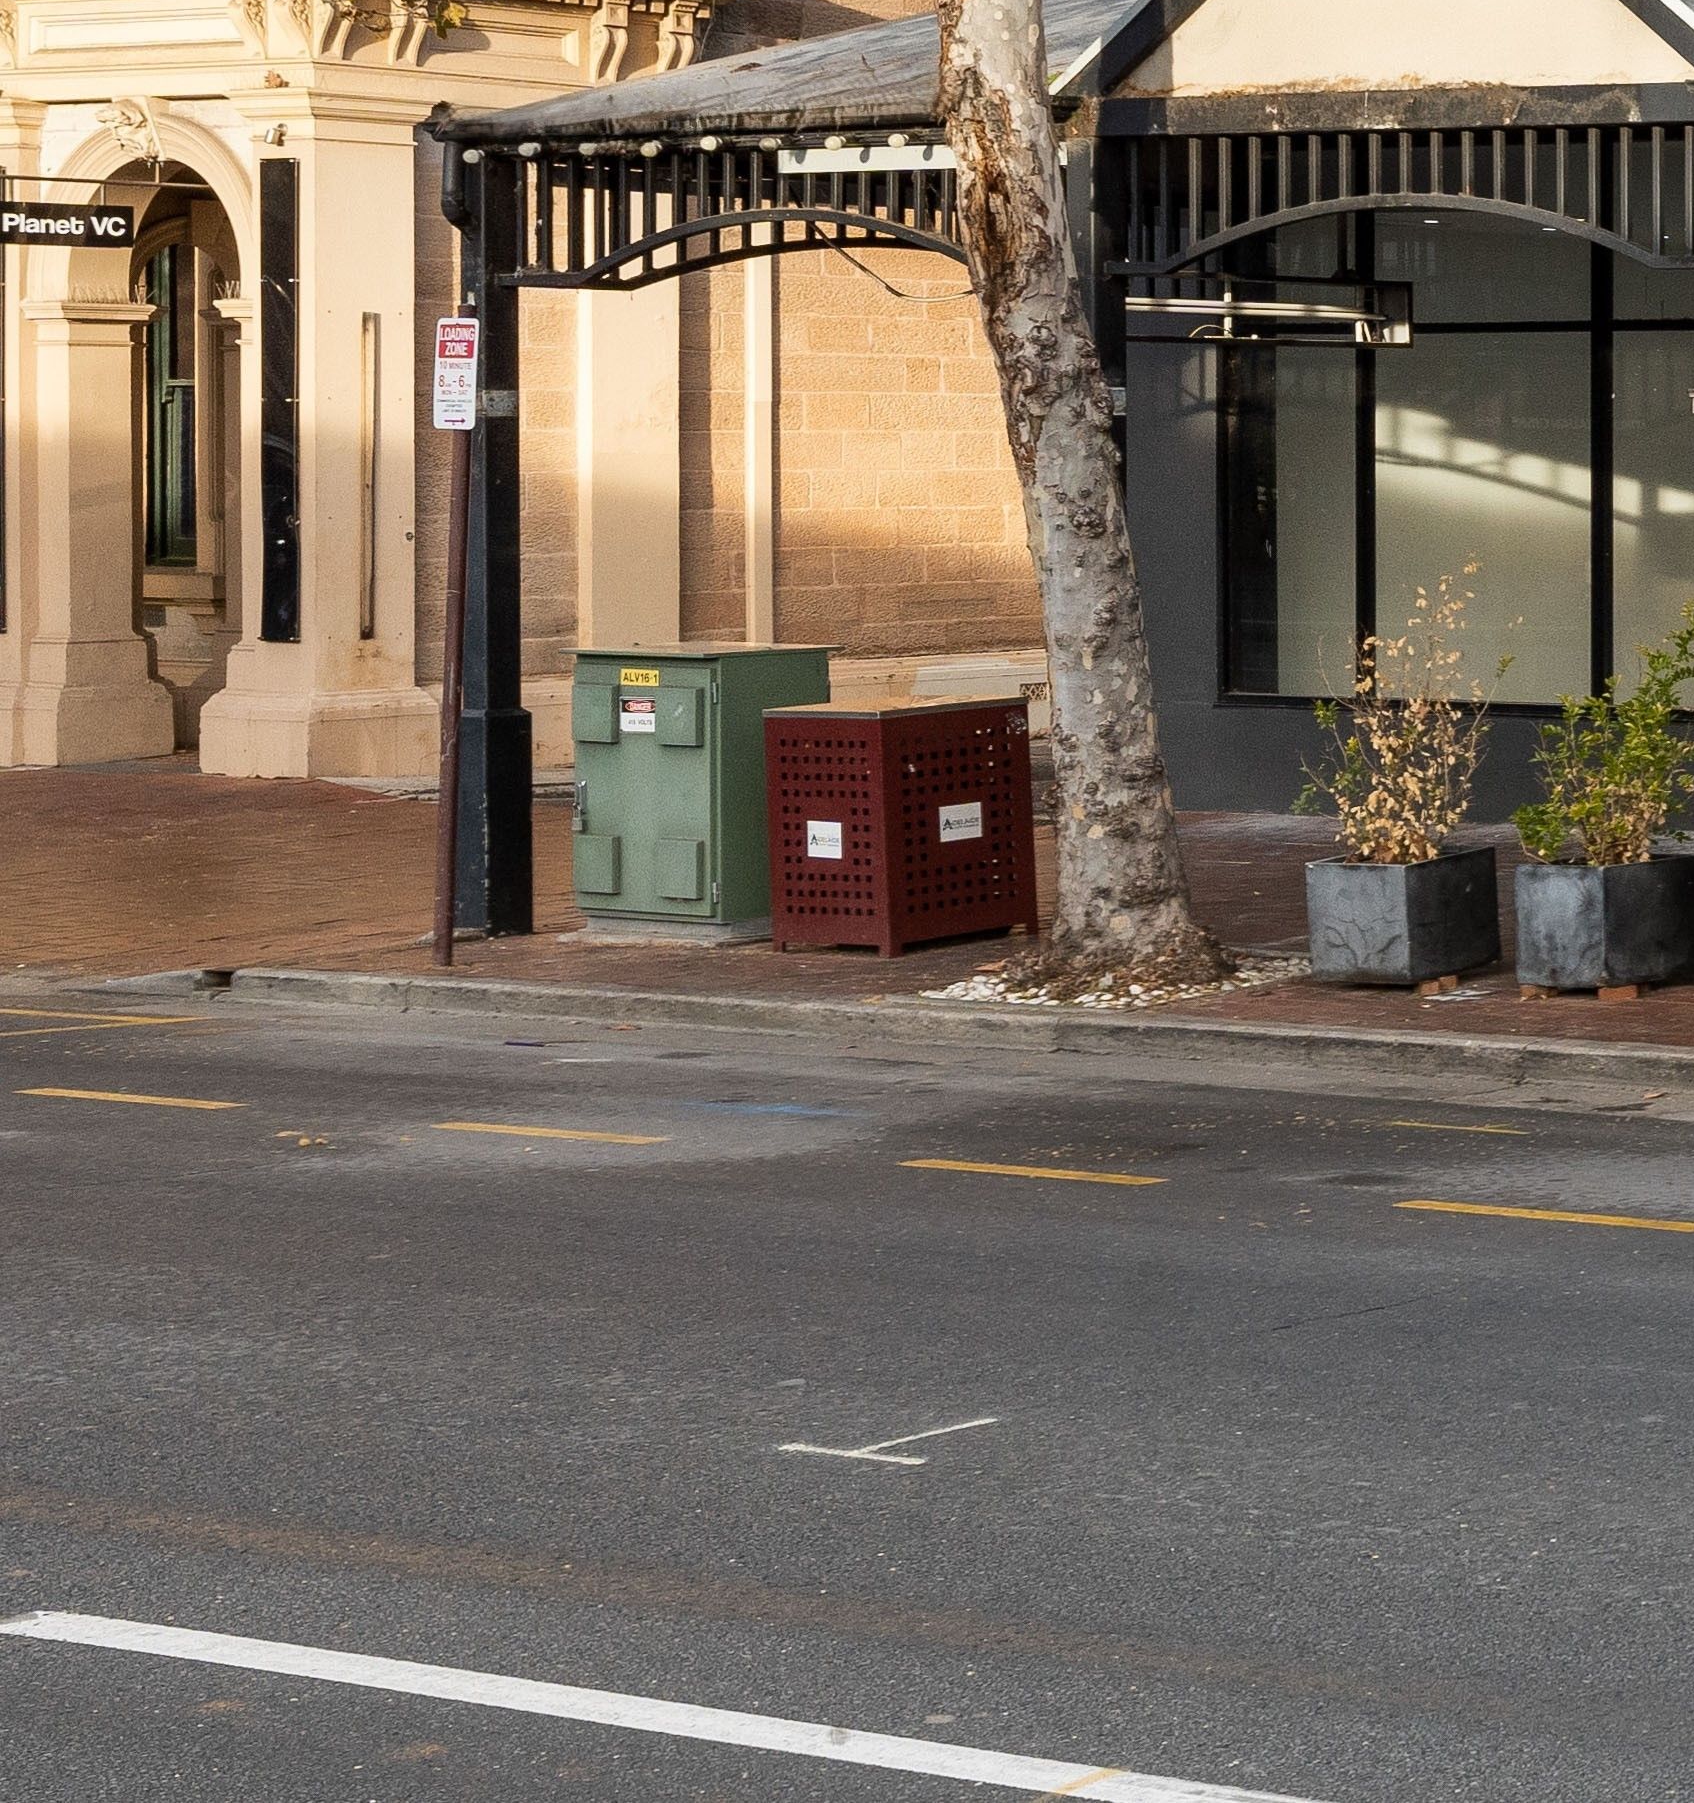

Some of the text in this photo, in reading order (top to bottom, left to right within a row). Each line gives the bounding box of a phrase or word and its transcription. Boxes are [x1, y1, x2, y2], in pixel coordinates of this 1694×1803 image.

[2, 213, 126, 237] Planet VC
[440, 327, 475, 341] LOADING
[445, 342, 469, 356] ZONE
[439, 361, 473, 370] 10 MINUTE
[623, 672, 658, 684] ALV16-1
